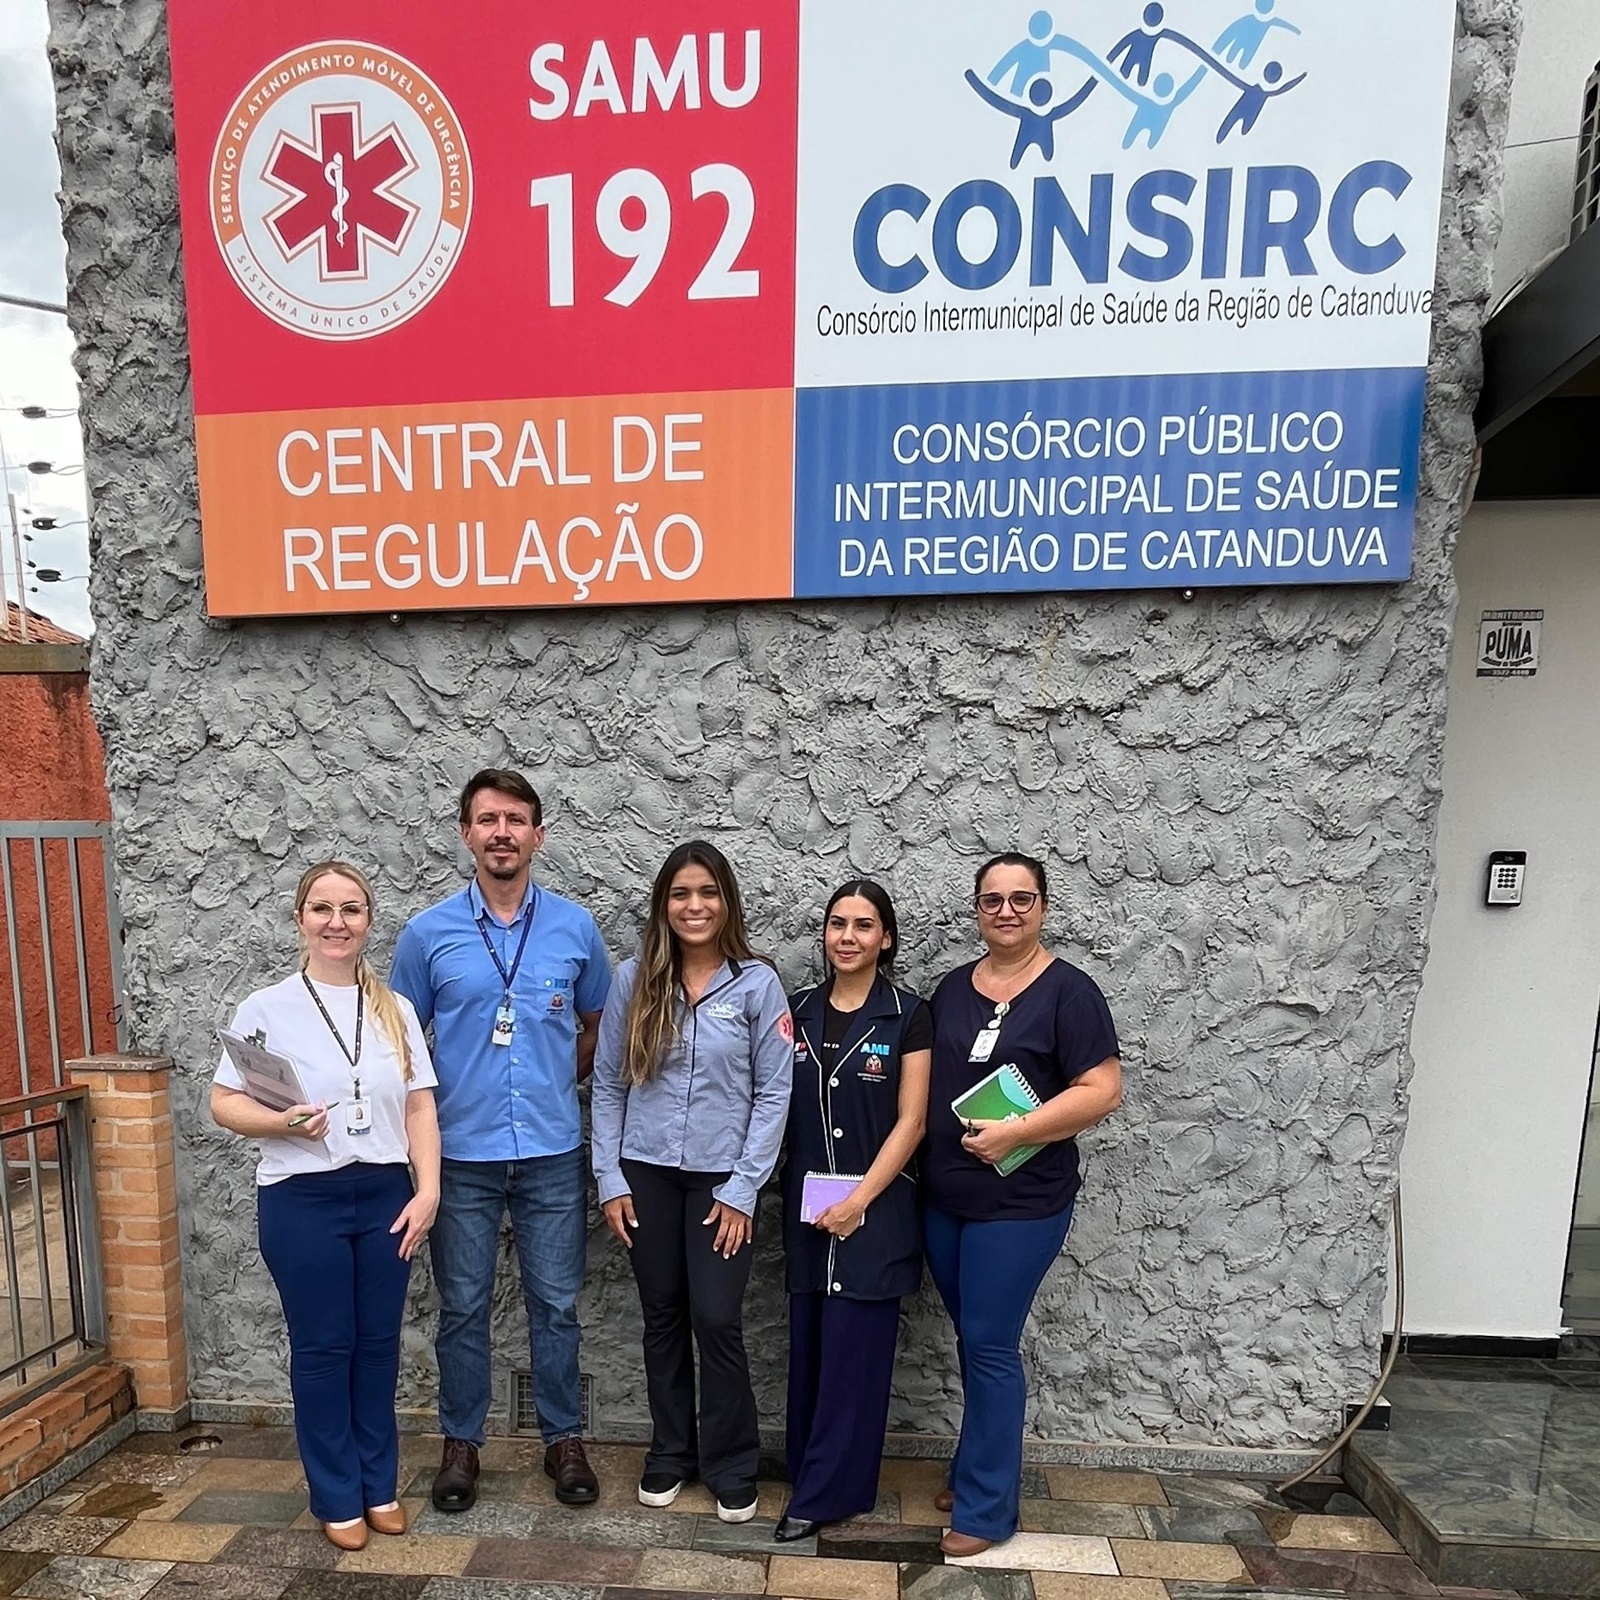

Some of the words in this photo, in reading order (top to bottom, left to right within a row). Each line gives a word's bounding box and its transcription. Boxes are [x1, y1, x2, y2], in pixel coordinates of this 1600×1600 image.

[529, 29, 762, 122] SAMU
[220, 146, 237, 225] SERVIÇO
[231, 117, 250, 142] DE
[247, 54, 356, 117] ATENDIMENTO
[362, 60, 414, 95] MÓVEL
[416, 91, 437, 115] DE
[433, 116, 462, 210] URGÊNCIA
[529, 163, 761, 308] 192
[853, 159, 1413, 295] CONSIRC
[236, 254, 299, 319] SISTEMA
[310, 311, 370, 329] ÚNICO
[381, 300, 402, 319] DE
[408, 242, 451, 300] SAÚDE
[817, 304, 917, 337] Consórcio
[924, 294, 1064, 336] Intermunicipal
[1070, 294, 1096, 327] de
[1102, 291, 1168, 326] Saúde
[1175, 290, 1199, 323] da
[1207, 288, 1280, 329] Região
[1287, 286, 1313, 319] de
[1320, 282, 1433, 317] Catanduva
[277, 418, 593, 498] CENTRAL
[612, 412, 705, 484] DE
[893, 411, 1146, 465] CONSÓRCIO
[1159, 405, 1344, 457] PÚBLICO
[835, 473, 1174, 523] INTERMUNICIPAL
[1185, 471, 1243, 514] DE
[1255, 460, 1401, 512] SAÚDE
[283, 502, 705, 601] REGULAÇÃO
[840, 538, 894, 578] DA
[904, 526, 1060, 577] REGIÃO
[1073, 531, 1128, 573] DE
[1141, 526, 1388, 571] CATANDUVA
[1483, 611, 1543, 620] MONITORADO
[1486, 627, 1532, 660] PUMA
[860, 1042, 890, 1056] AME
